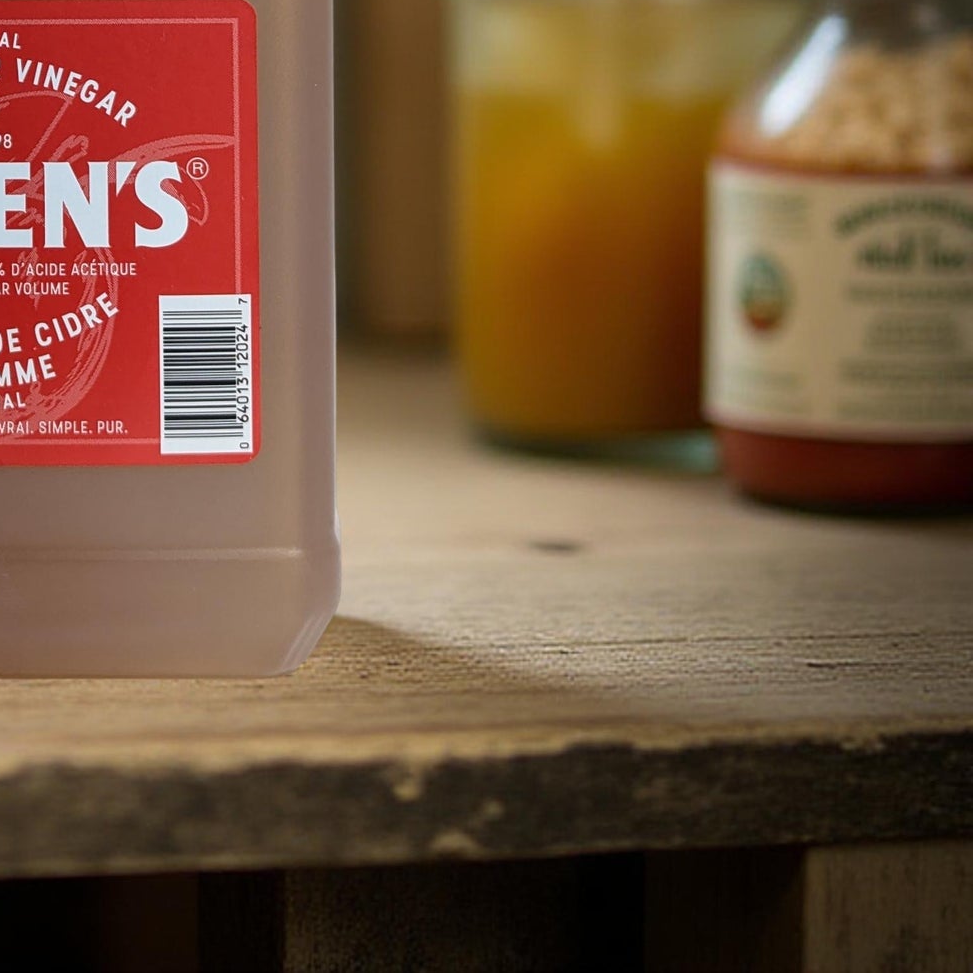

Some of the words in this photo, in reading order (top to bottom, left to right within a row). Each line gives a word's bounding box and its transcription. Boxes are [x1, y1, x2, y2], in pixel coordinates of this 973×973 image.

[16, 57, 137, 128] VINEGAR
[11, 262, 66, 276] D'ACIDE
[71, 258, 137, 276] ACÉTIQUE
[14, 282, 70, 295] VOLUME
[34, 292, 119, 347] CIDRE
[235, 324, 249, 369] 12024
[236, 377, 250, 423] 64013
[38, 420, 93, 434] SIMPLE.
[97, 420, 129, 434] PUR.
